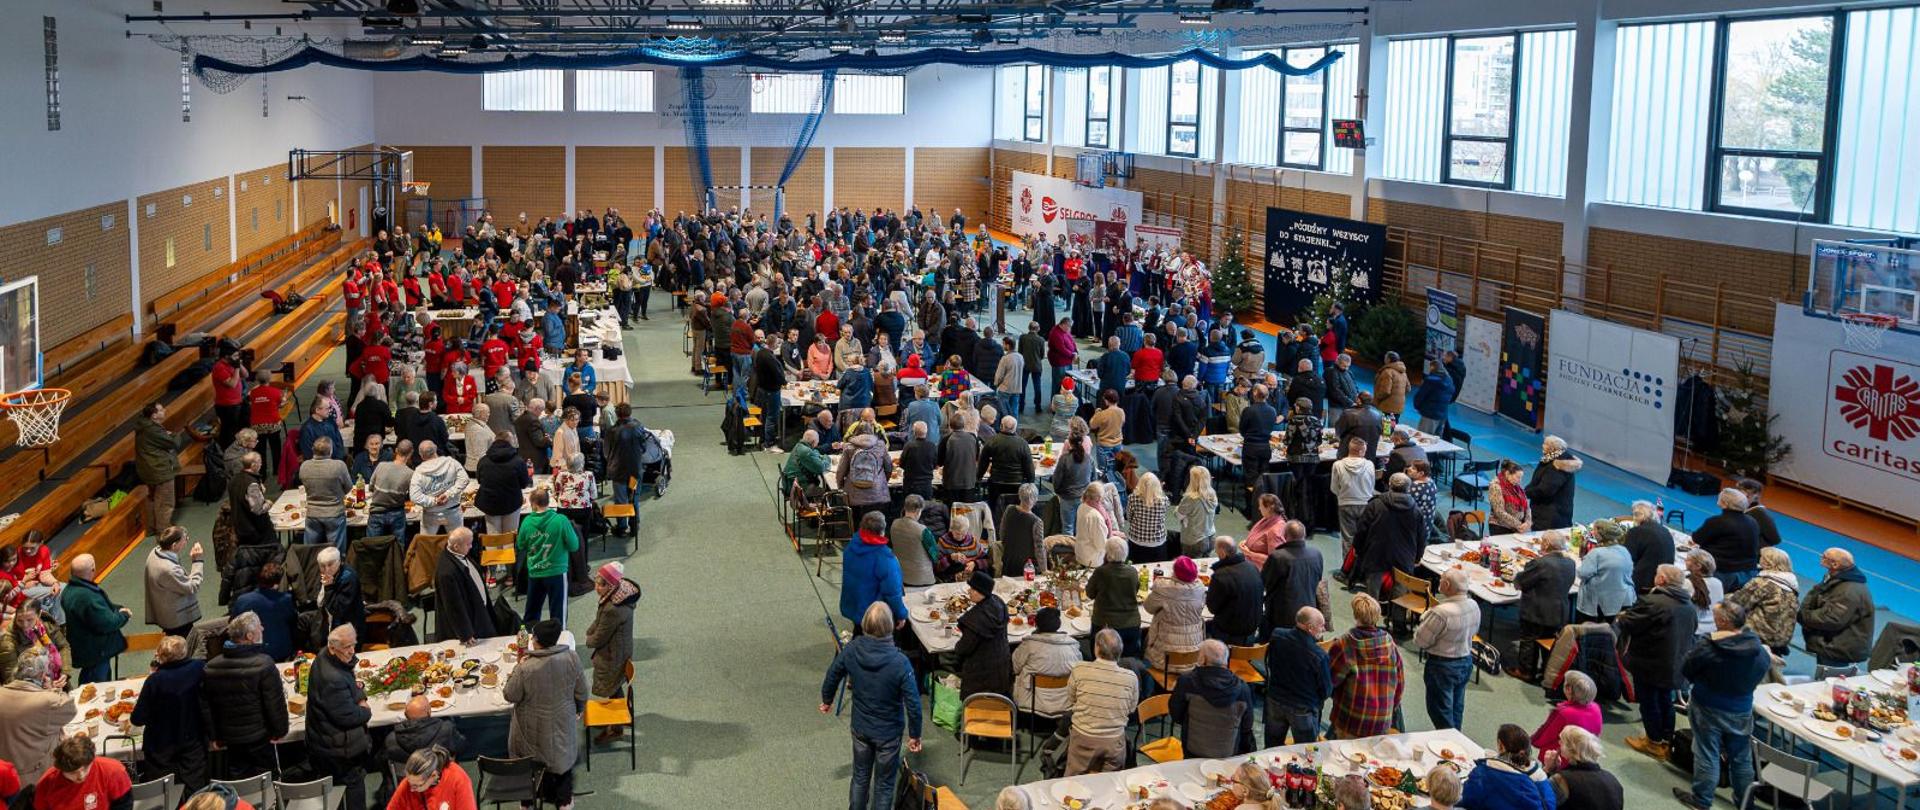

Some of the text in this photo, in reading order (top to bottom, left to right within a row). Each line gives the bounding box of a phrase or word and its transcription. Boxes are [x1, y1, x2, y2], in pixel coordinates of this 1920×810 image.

[1279, 230, 1290, 239] DO
[1332, 228, 1369, 243] WSZYSCY
[1559, 359, 1640, 395] FUNDACJA
[1856, 386, 1908, 421] CARITAS
[1833, 439, 1920, 475] caritas
